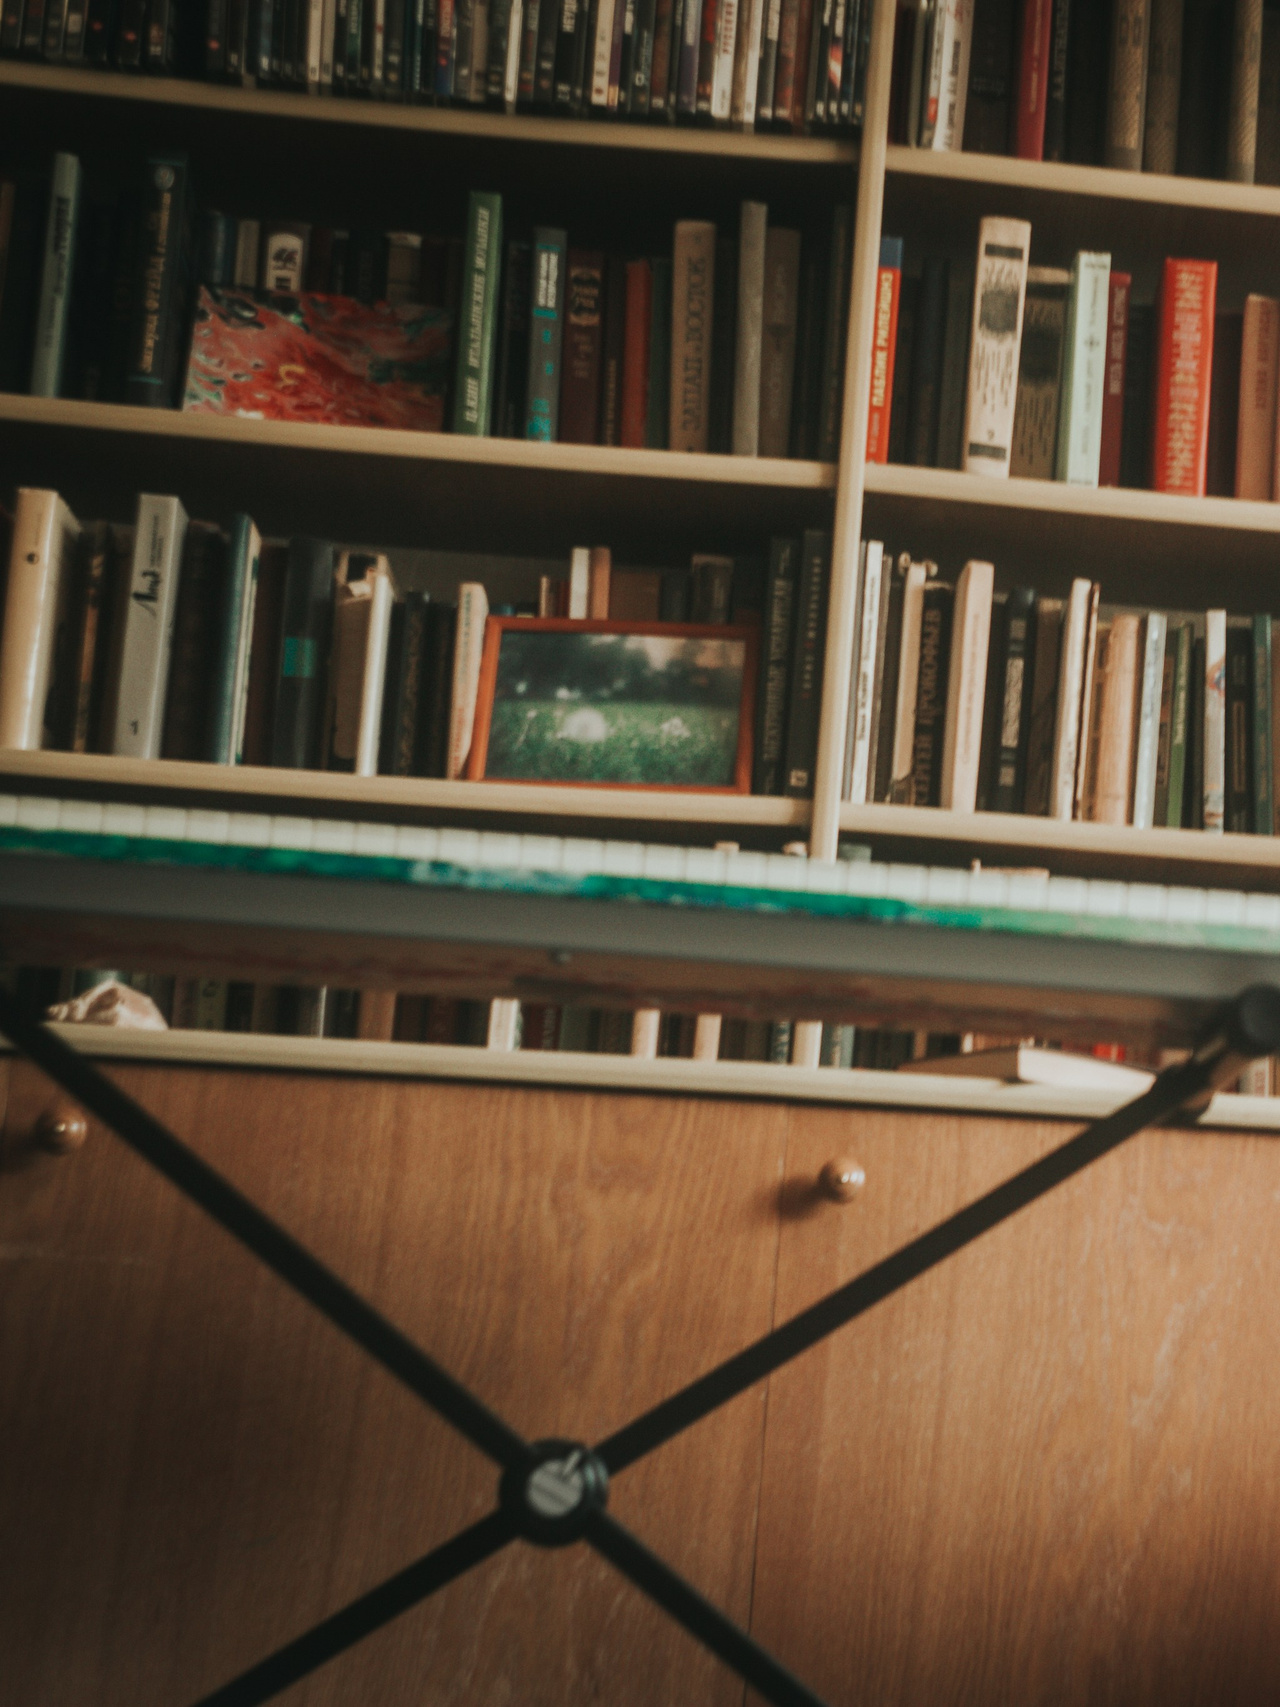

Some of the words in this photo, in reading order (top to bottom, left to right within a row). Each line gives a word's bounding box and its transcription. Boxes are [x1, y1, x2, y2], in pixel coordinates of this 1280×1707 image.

[146, 254, 166, 312] ФРЕЙД
[876, 272, 895, 348] РИЛЕЙШНЗ
[872, 349, 890, 408] ПАБЛИК
[918, 607, 943, 726] ПРОКОФЬЕВ
[914, 732, 934, 805] СЕРГЕЙ
